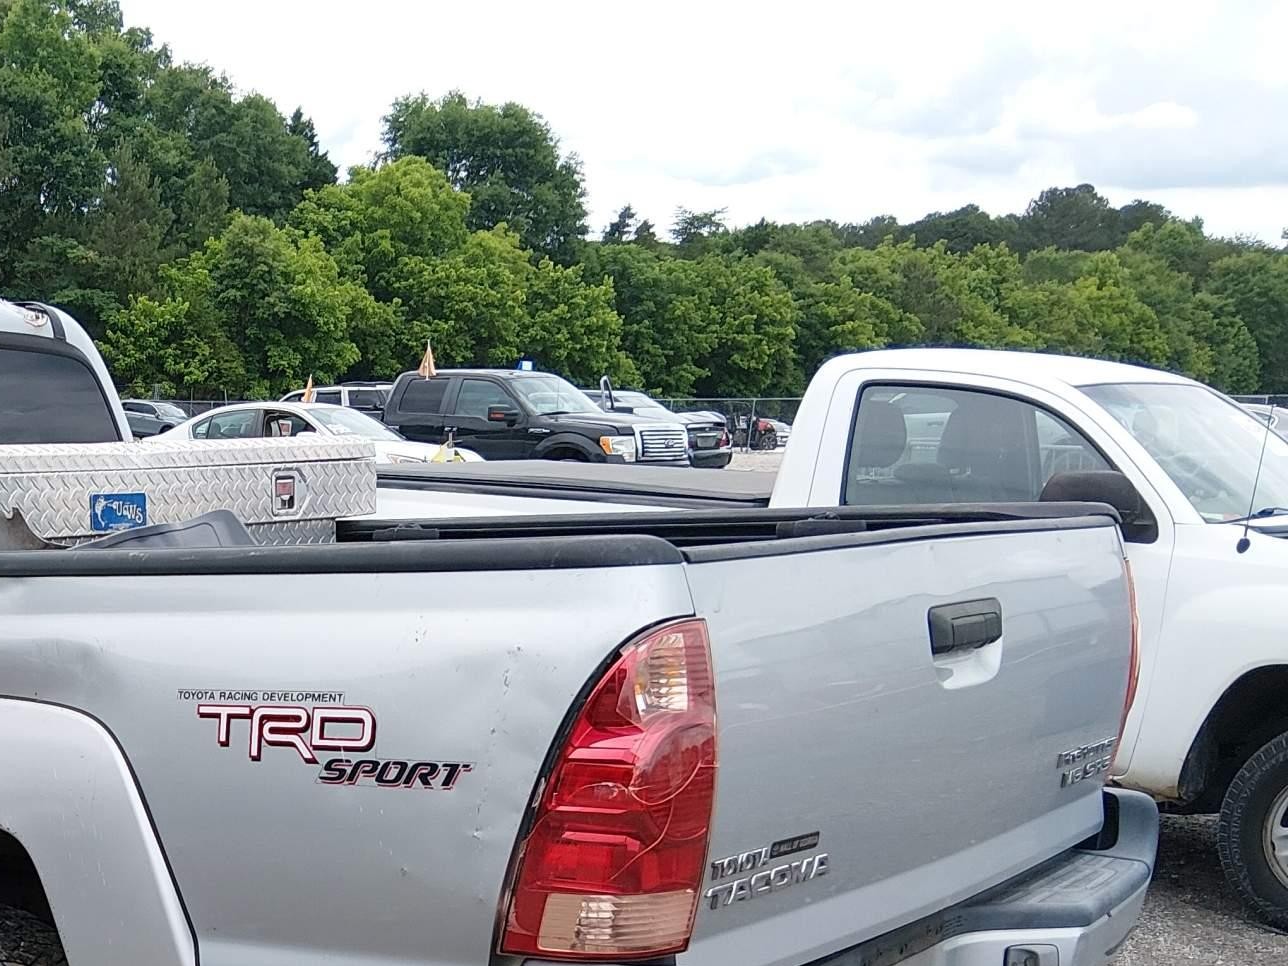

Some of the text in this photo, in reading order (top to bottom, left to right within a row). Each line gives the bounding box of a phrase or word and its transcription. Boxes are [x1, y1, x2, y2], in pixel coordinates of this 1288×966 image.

[177, 690, 343, 703] TOYOTA RACING DEVELOPMENT
[197, 703, 379, 764] TRD
[318, 758, 473, 790] SPORT
[711, 847, 770, 880] TOYOTA
[704, 853, 829, 910] TACOMA
